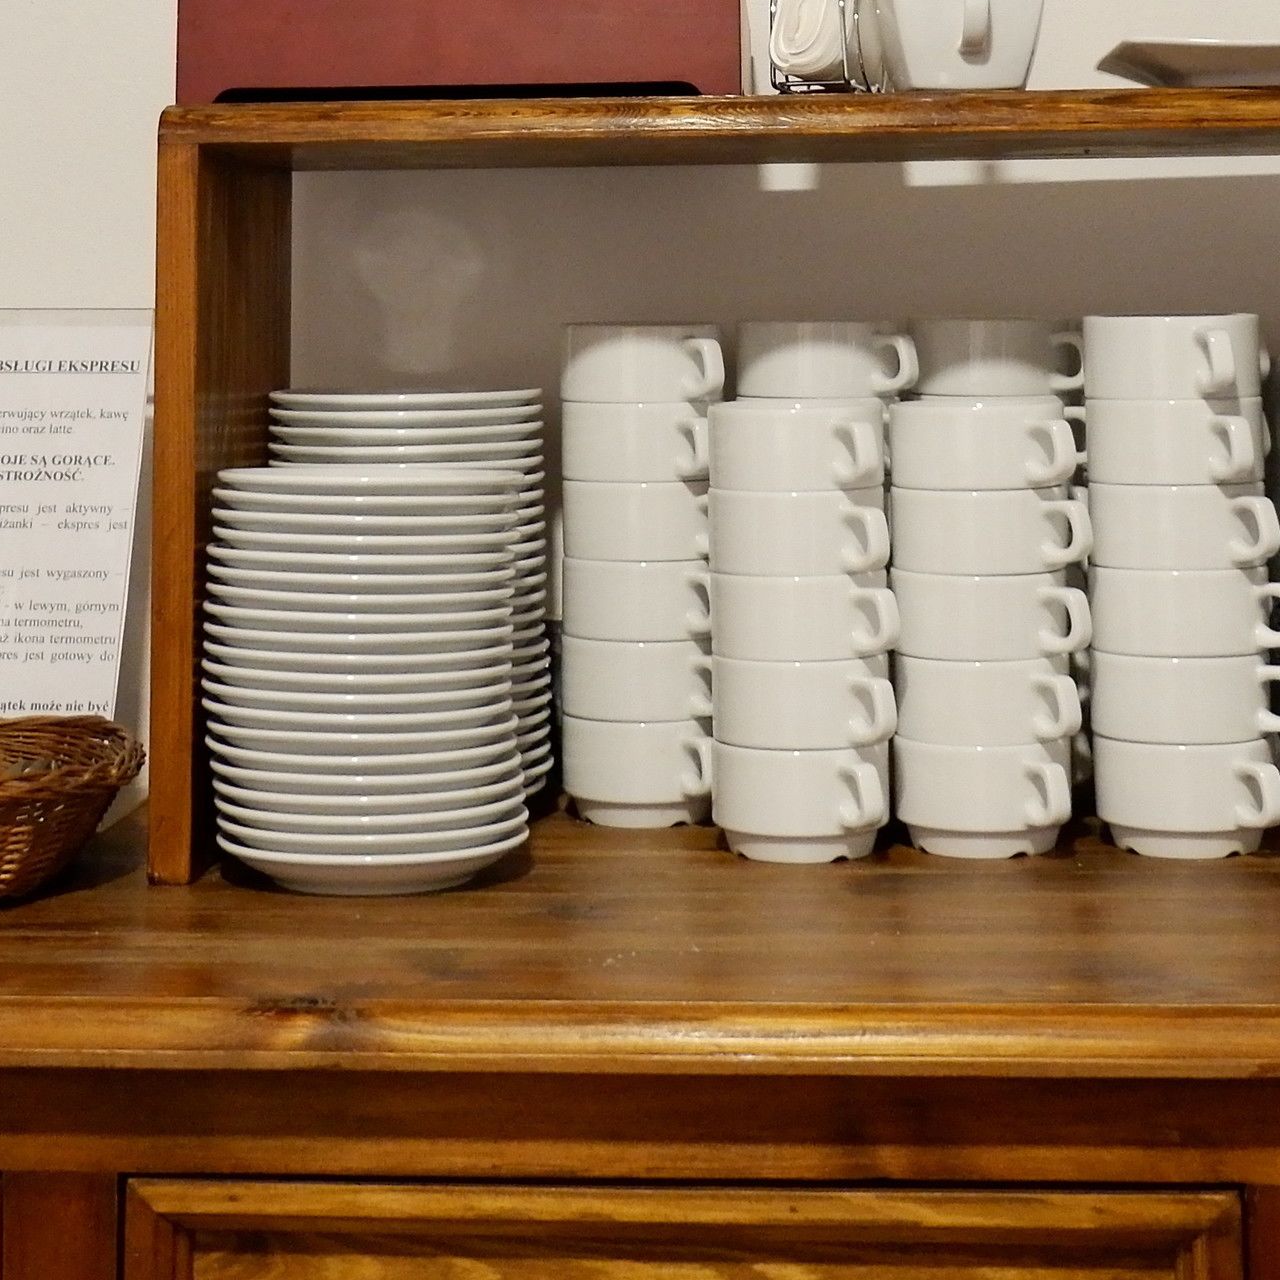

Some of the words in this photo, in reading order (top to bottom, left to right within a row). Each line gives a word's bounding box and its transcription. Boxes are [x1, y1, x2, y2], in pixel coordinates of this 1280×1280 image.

[58, 360, 141, 372] EKSPRESU
[100, 408, 129, 421] kawę
[22, 426, 46, 434] oraz
[30, 455, 47, 468] SĄ
[52, 455, 116, 468] GORĄCE.
[36, 503, 57, 515] jest
[65, 503, 113, 515] aktywny
[57, 520, 100, 531] ekspres
[107, 520, 128, 531] jest
[19, 568, 40, 580] jest
[46, 570, 109, 581] wygaszony
[14, 602, 25, 611] w
[75, 602, 120, 615] górnym
[13, 634, 45, 644] ikona
[49, 635, 116, 646] termometru
[23, 650, 45, 663] jest
[50, 651, 93, 664] gotowy
[99, 651, 115, 662] do
[30, 700, 62, 712] może
[66, 701, 84, 712] nie
[87, 701, 109, 714] być
